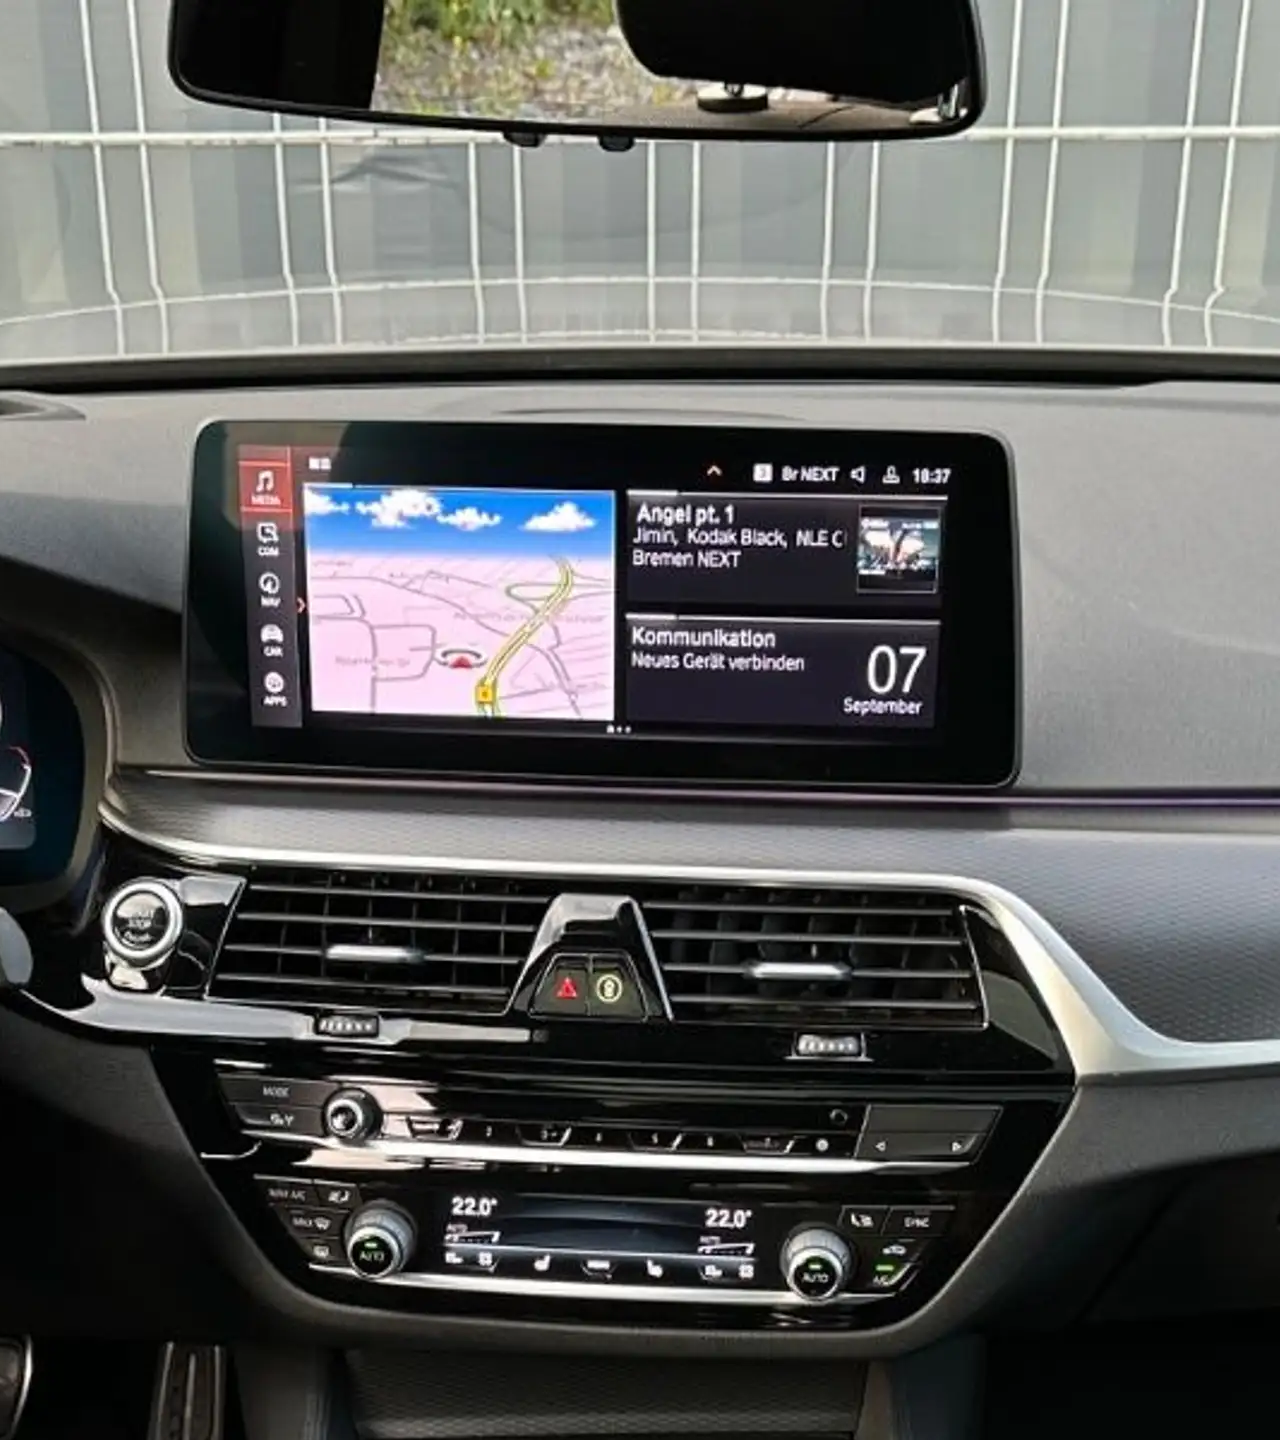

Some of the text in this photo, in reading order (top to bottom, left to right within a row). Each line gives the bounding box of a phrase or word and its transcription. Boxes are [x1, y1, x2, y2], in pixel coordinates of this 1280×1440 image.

[801, 466, 840, 482] NEXT
[636, 503, 734, 526] Angel pt. 1
[633, 526, 848, 548] Jimin, Kodak Black, NLE C
[632, 549, 742, 568] Bremen NEXT
[632, 627, 776, 648] Kommunikation
[631, 651, 805, 671] Neues Gerät verbinden
[867, 645, 927, 694] 07
[843, 697, 923, 716] September
[803, 1272, 829, 1283] AUTO
